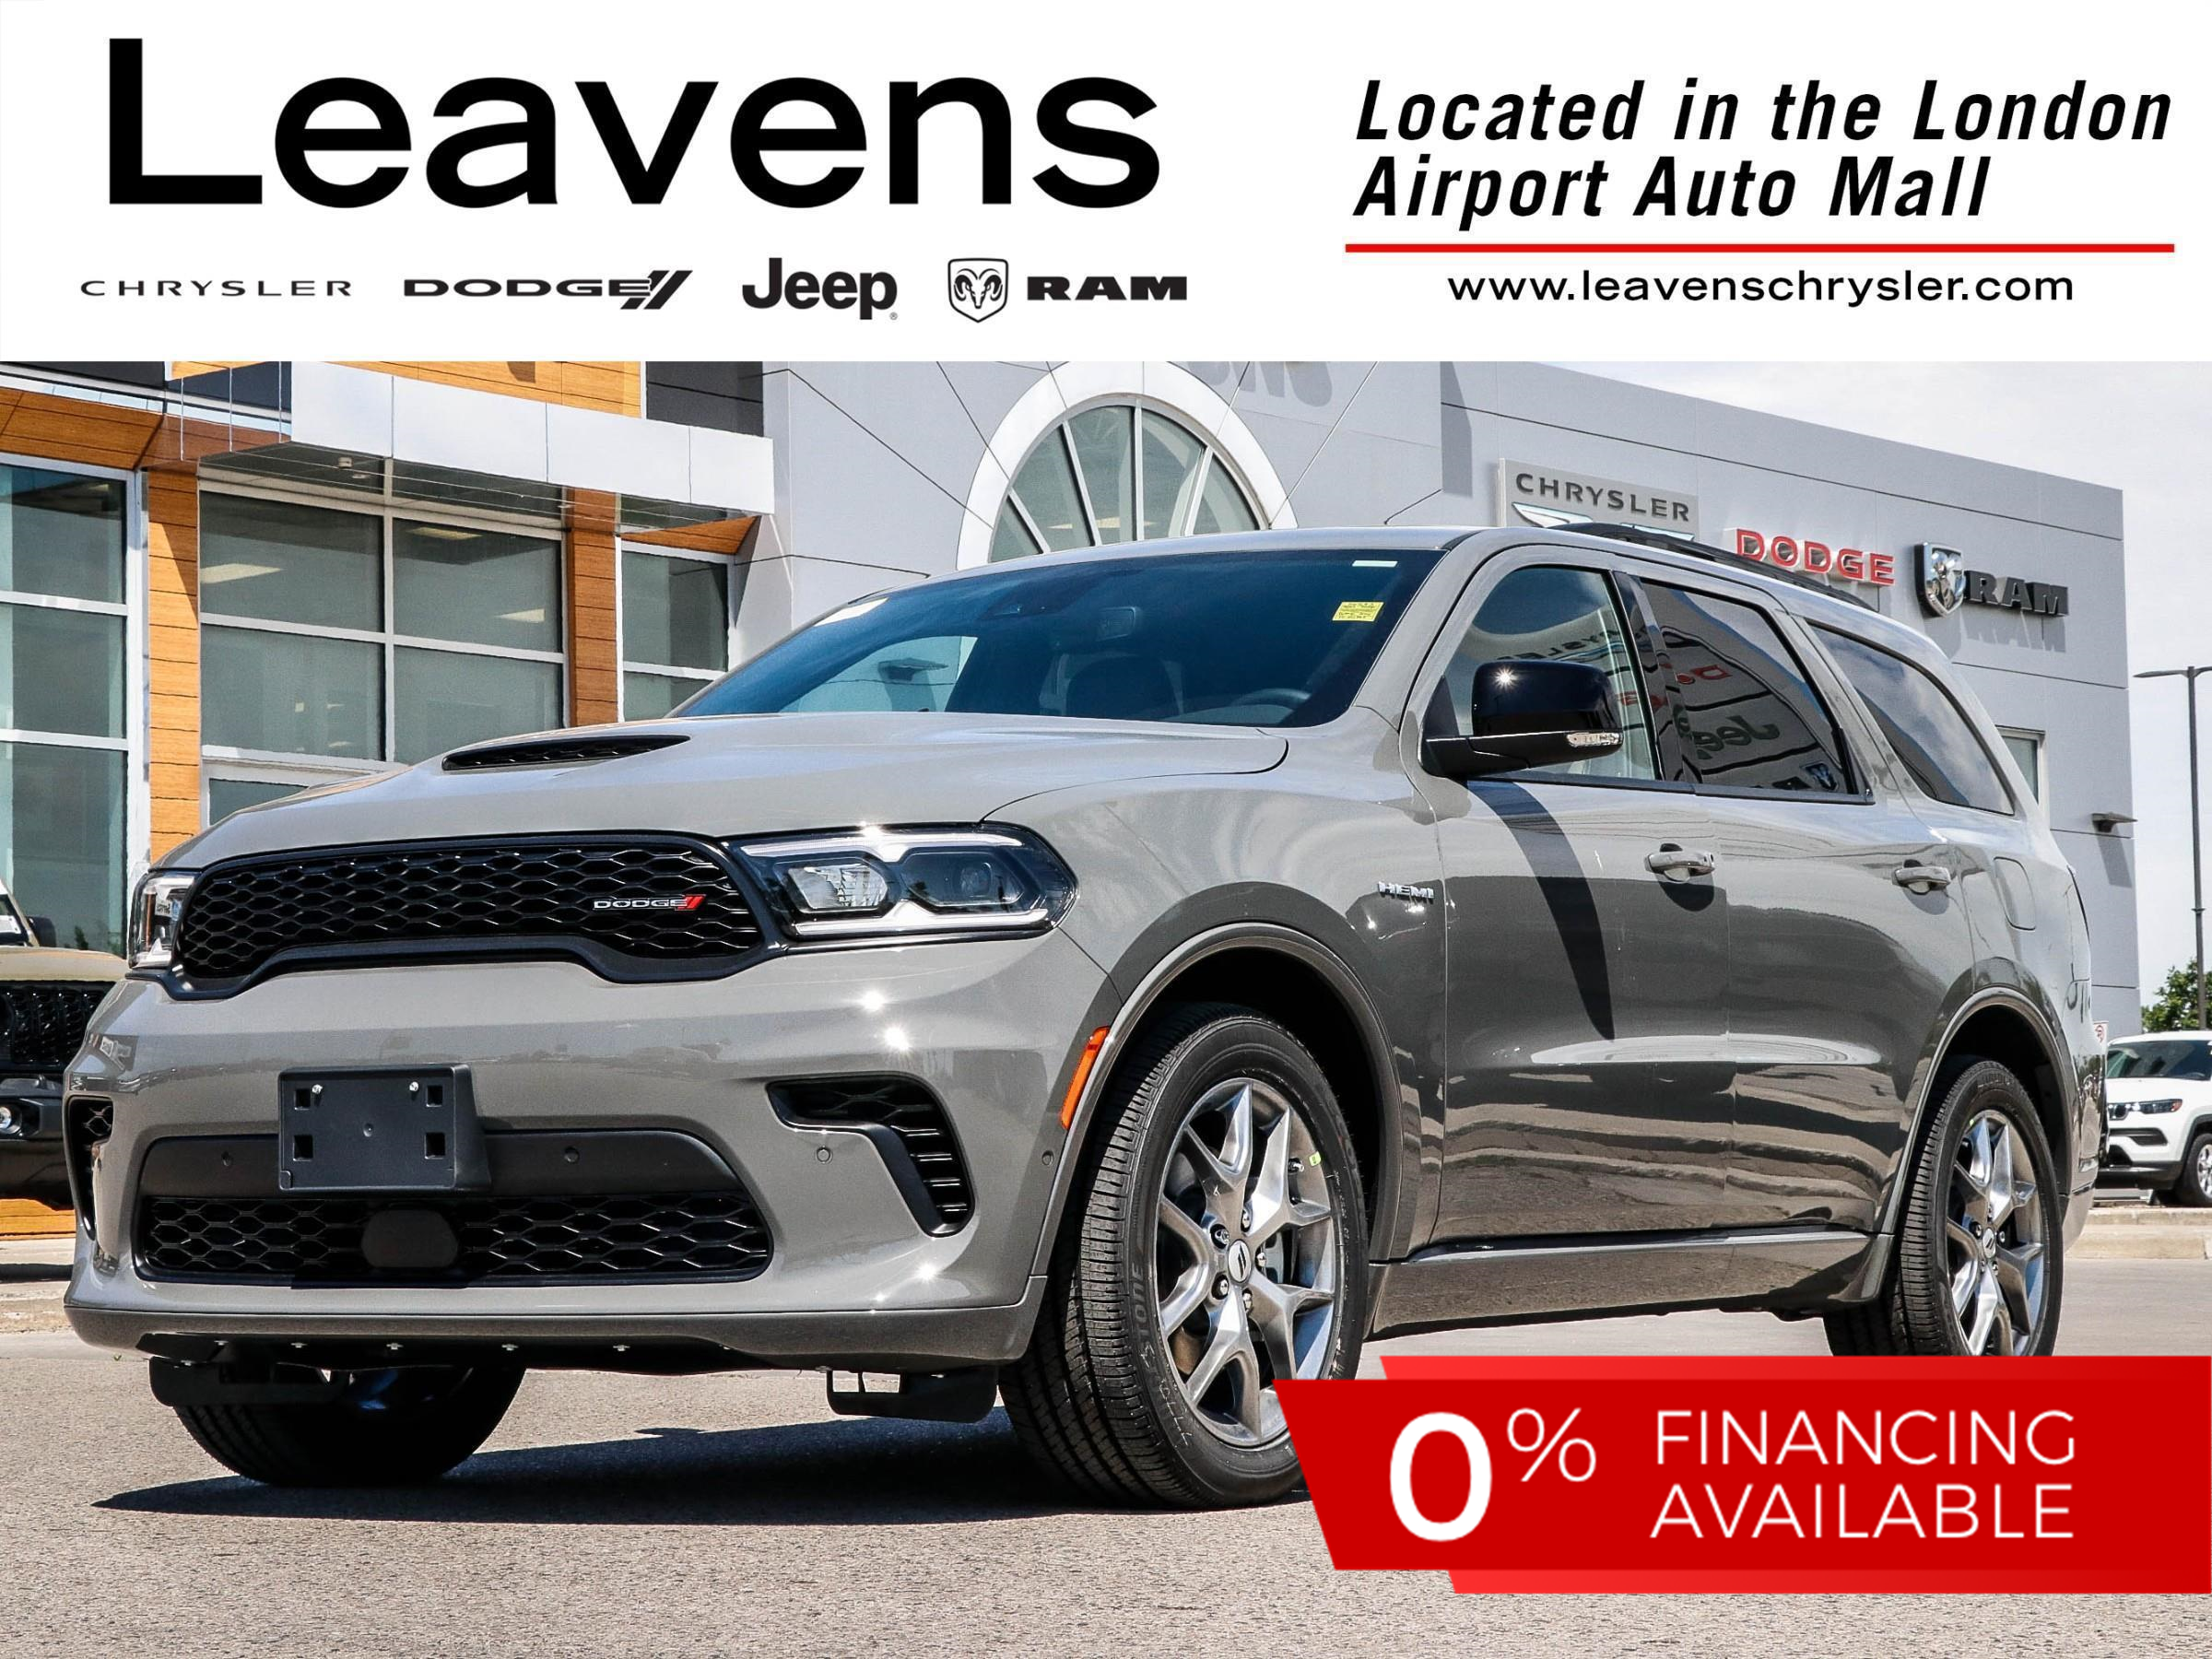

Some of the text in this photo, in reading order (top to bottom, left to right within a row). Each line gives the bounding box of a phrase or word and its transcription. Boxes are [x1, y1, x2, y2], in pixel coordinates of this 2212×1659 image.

[1515, 472, 1689, 522] CHRYSLER
[1735, 527, 1896, 587] DODGE
[1965, 570, 2069, 617] RAM
[594, 899, 688, 910] DODGE
[1378, 880, 1434, 899] HEMI
